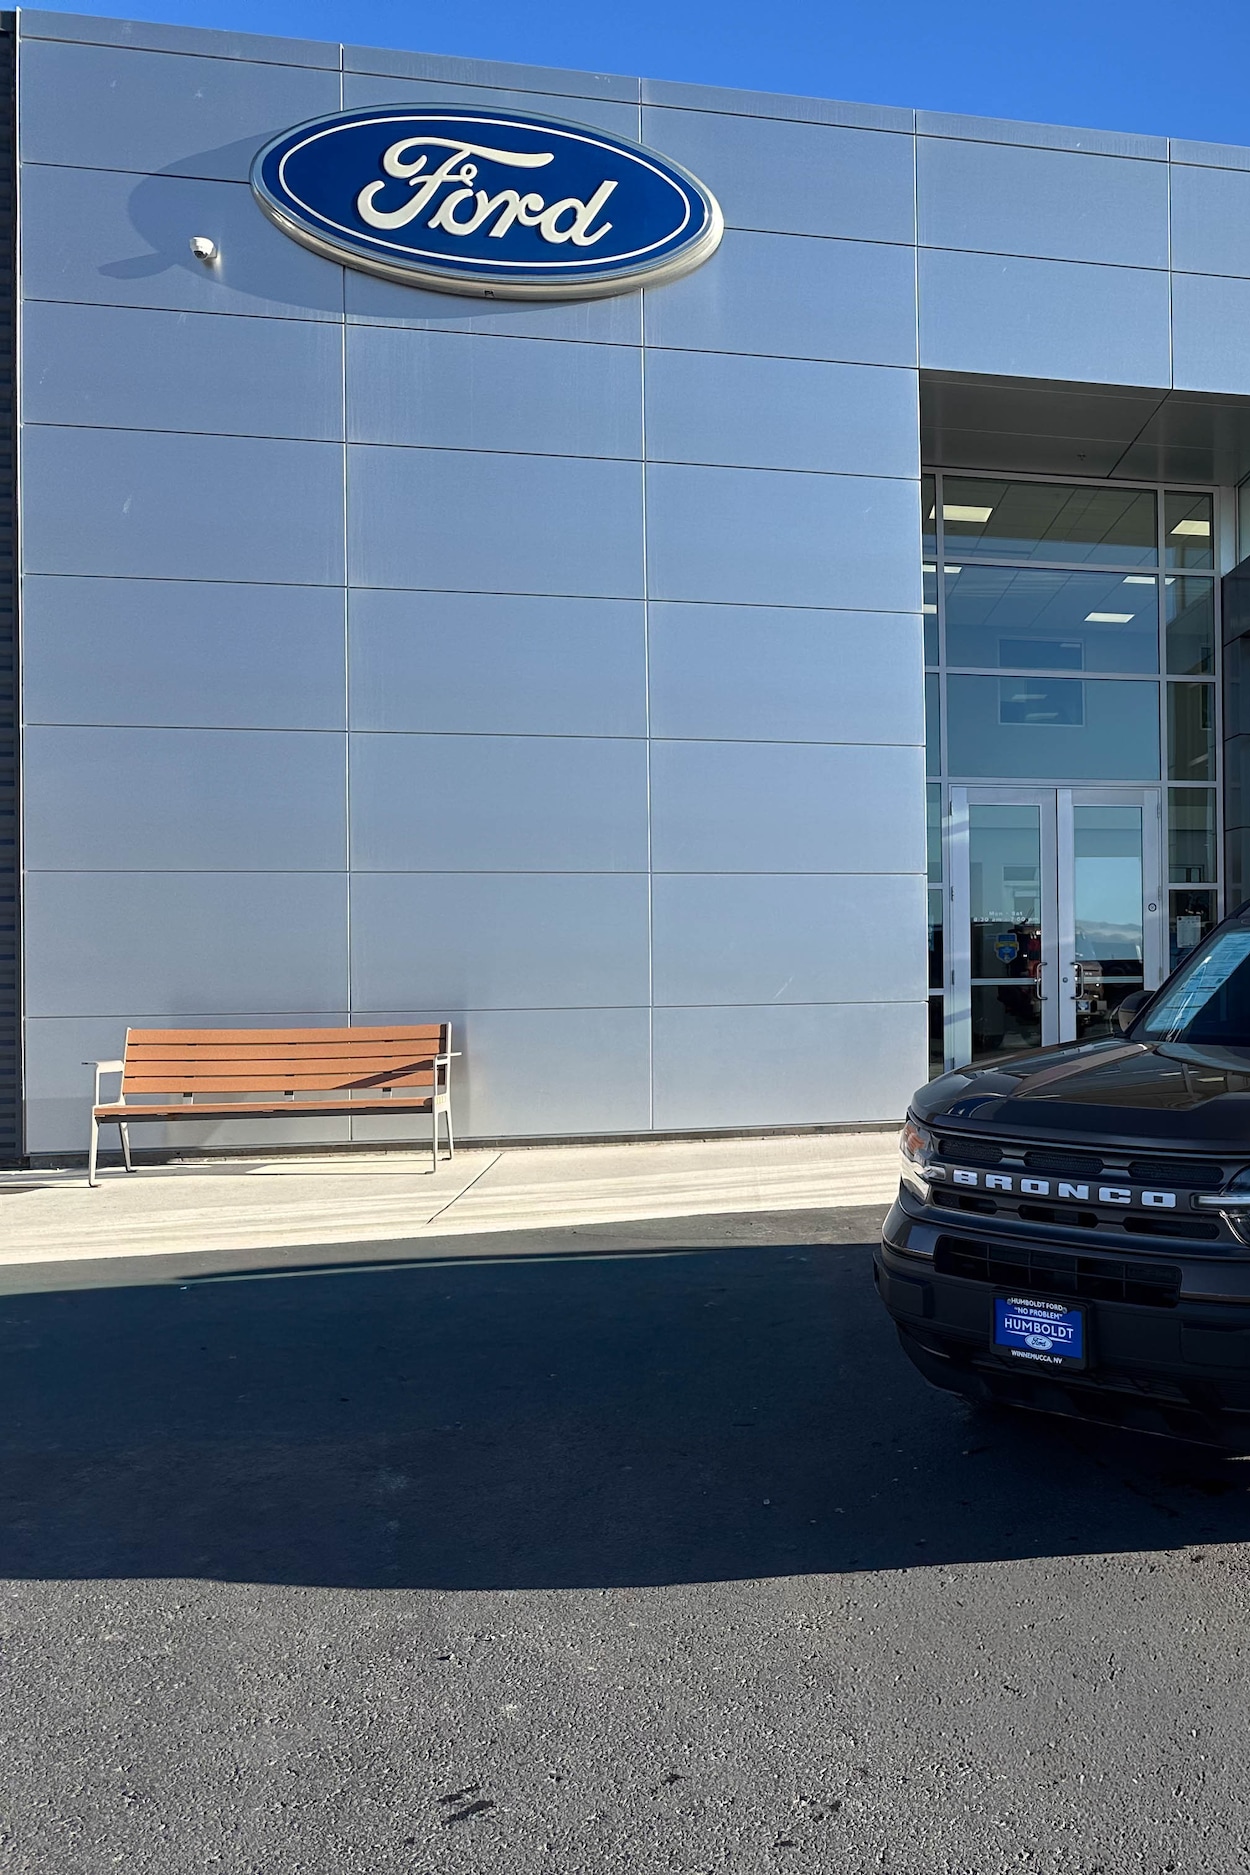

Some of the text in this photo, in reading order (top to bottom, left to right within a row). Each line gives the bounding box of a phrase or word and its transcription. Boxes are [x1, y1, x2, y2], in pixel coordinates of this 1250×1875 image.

[356, 136, 618, 248] Ford
[952, 1169, 1177, 1209] BRONCO
[1010, 1297, 1063, 1312] HUMBOLDT FORD
[1004, 1317, 1074, 1339] HUMBOLDT
